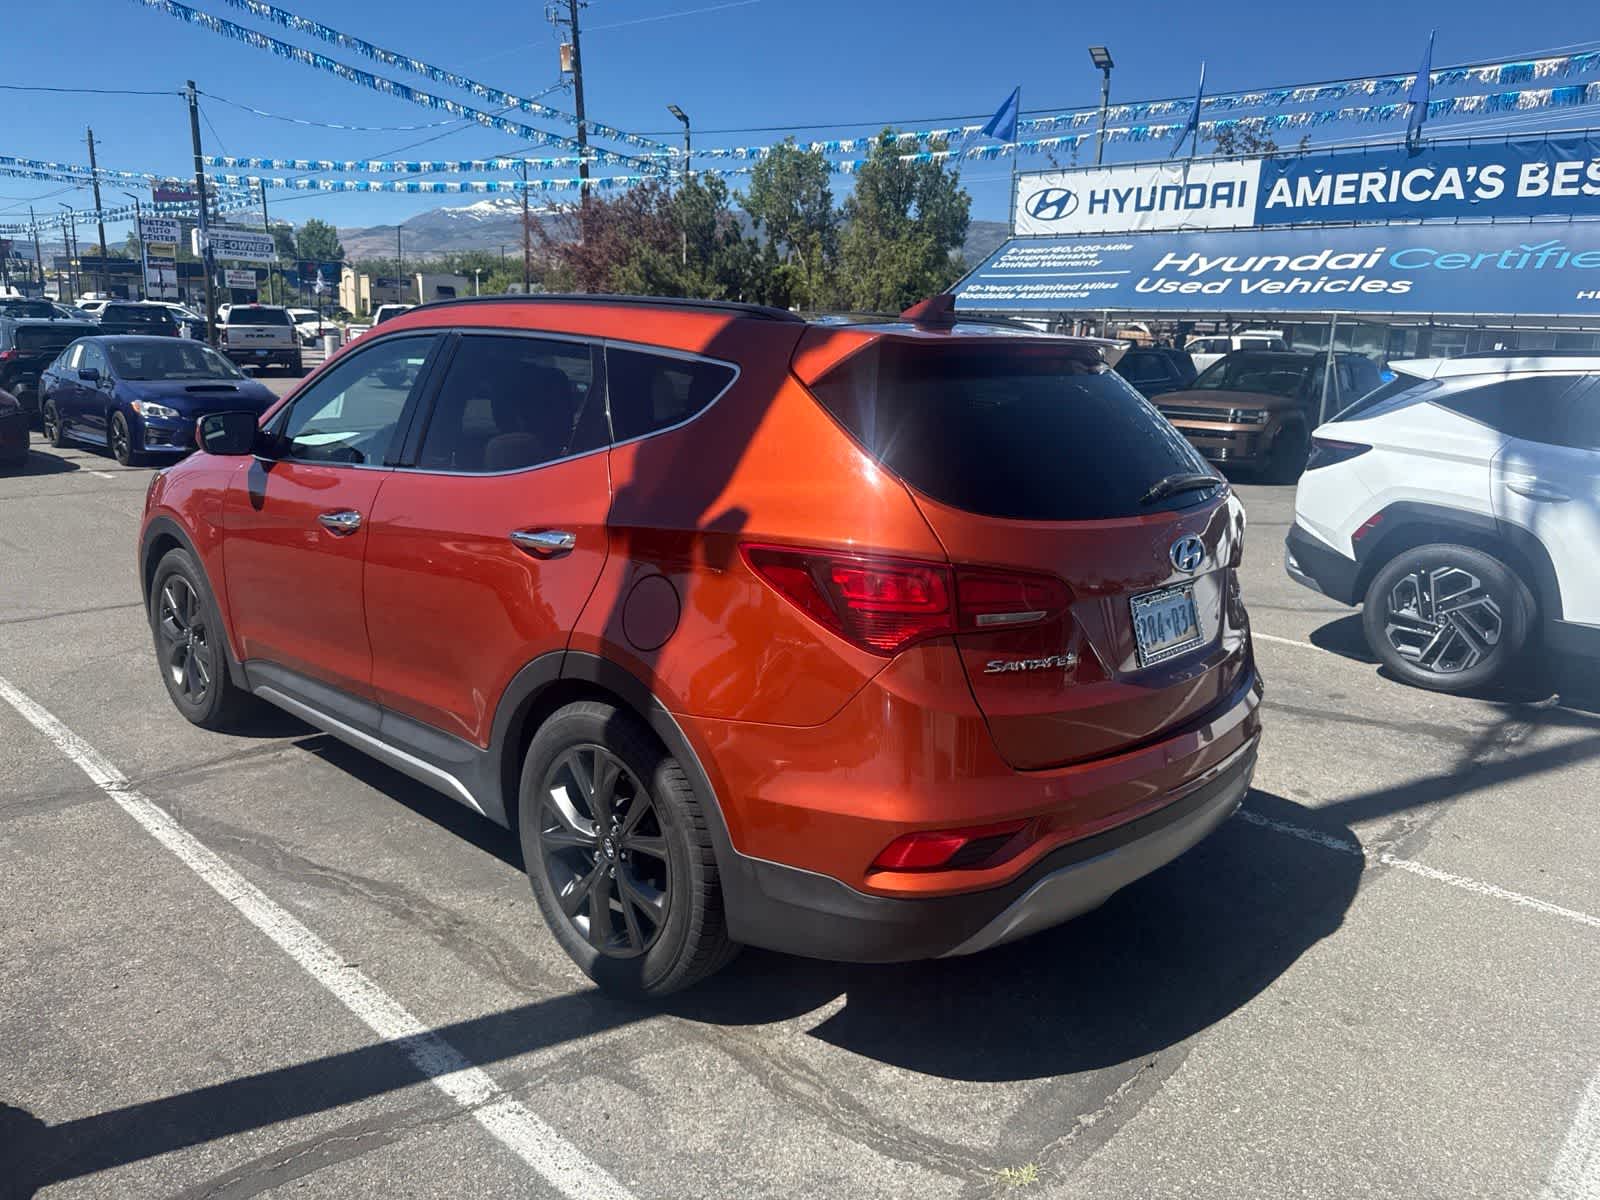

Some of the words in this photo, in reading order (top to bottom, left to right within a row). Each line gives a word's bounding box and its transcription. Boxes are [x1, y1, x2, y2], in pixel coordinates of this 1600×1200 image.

[1264, 165, 1506, 209] AMERICA'S
[1088, 180, 1248, 215] HYUNDAI
[142, 233, 177, 242] CENTER
[210, 240, 271, 252] RE-OWNED
[1000, 252, 1099, 263] Comprehensive
[1152, 246, 1387, 277] Hyundai
[991, 260, 1040, 269] Limited
[1040, 259, 1103, 270] Warranty
[1080, 281, 1120, 290] Miles
[1134, 277, 1233, 295] Used
[1239, 275, 1415, 295] Vehicles
[956, 291, 1017, 300] Roadside
[1016, 290, 1091, 300] Assistance
